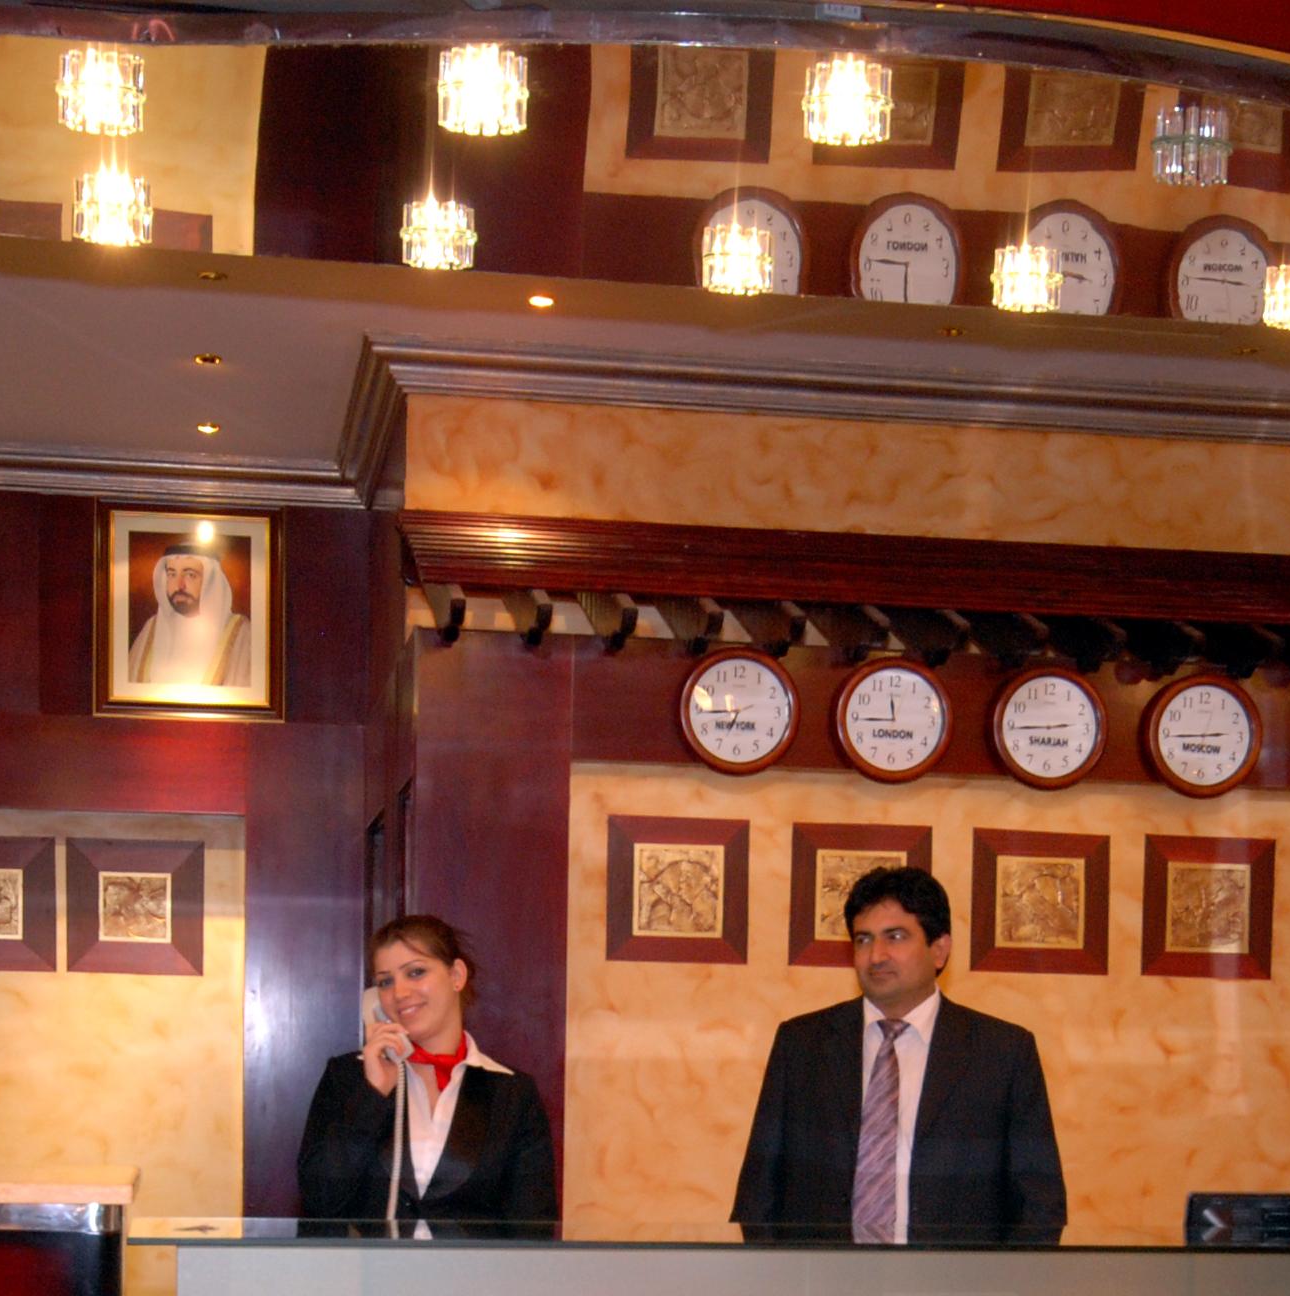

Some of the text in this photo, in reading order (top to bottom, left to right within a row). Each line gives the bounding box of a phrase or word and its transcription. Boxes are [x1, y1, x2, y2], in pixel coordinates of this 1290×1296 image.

[716, 670, 727, 682] 11
[733, 665, 746, 679] 12
[873, 680, 882, 692] 11
[890, 675, 901, 688] 12
[769, 687, 776, 699] 2
[1028, 688, 1037, 700] 11
[1044, 683, 1056, 695] 12
[858, 694, 870, 705] 10
[925, 696, 930, 709] 2
[1183, 696, 1192, 709] 11
[1199, 692, 1211, 704] 12
[774, 707, 781, 719] 3
[1014, 702, 1026, 713] 10
[1078, 704, 1085, 715] 2
[851, 712, 859, 722] 9
[928, 716, 935, 728] 3
[1169, 710, 1181, 722] 10
[1232, 713, 1239, 724] 2
[701, 723, 708, 735] 8
[736, 721, 755, 730] YORK
[1007, 720, 1014, 731] 9
[1083, 723, 1089, 735] 3
[767, 727, 773, 737] 4
[857, 732, 862, 744] 8
[873, 729, 913, 739] LONDON
[1163, 728, 1169, 739] 9
[1237, 731, 1243, 744] 3
[716, 738, 723, 750] 7
[753, 740, 759, 752] 5
[921, 736, 927, 747] 4
[1013, 740, 1019, 752] 8
[1029, 736, 1068, 747] SHARJAH
[733, 744, 740, 755] 6
[871, 746, 877, 758] 7
[1076, 744, 1082, 753] 4
[1167, 749, 1174, 760] 8
[1182, 743, 1220, 754] MOSCOW
[887, 753, 895, 764] 6
[907, 749, 913, 761] 5
[1027, 754, 1033, 765] 7
[1062, 755, 1068, 767] 5
[1229, 752, 1235, 762] 4
[1043, 760, 1050, 771] 6
[1181, 762, 1188, 774] 7
[1215, 764, 1222, 776] 5
[1197, 769, 1204, 779] 6
